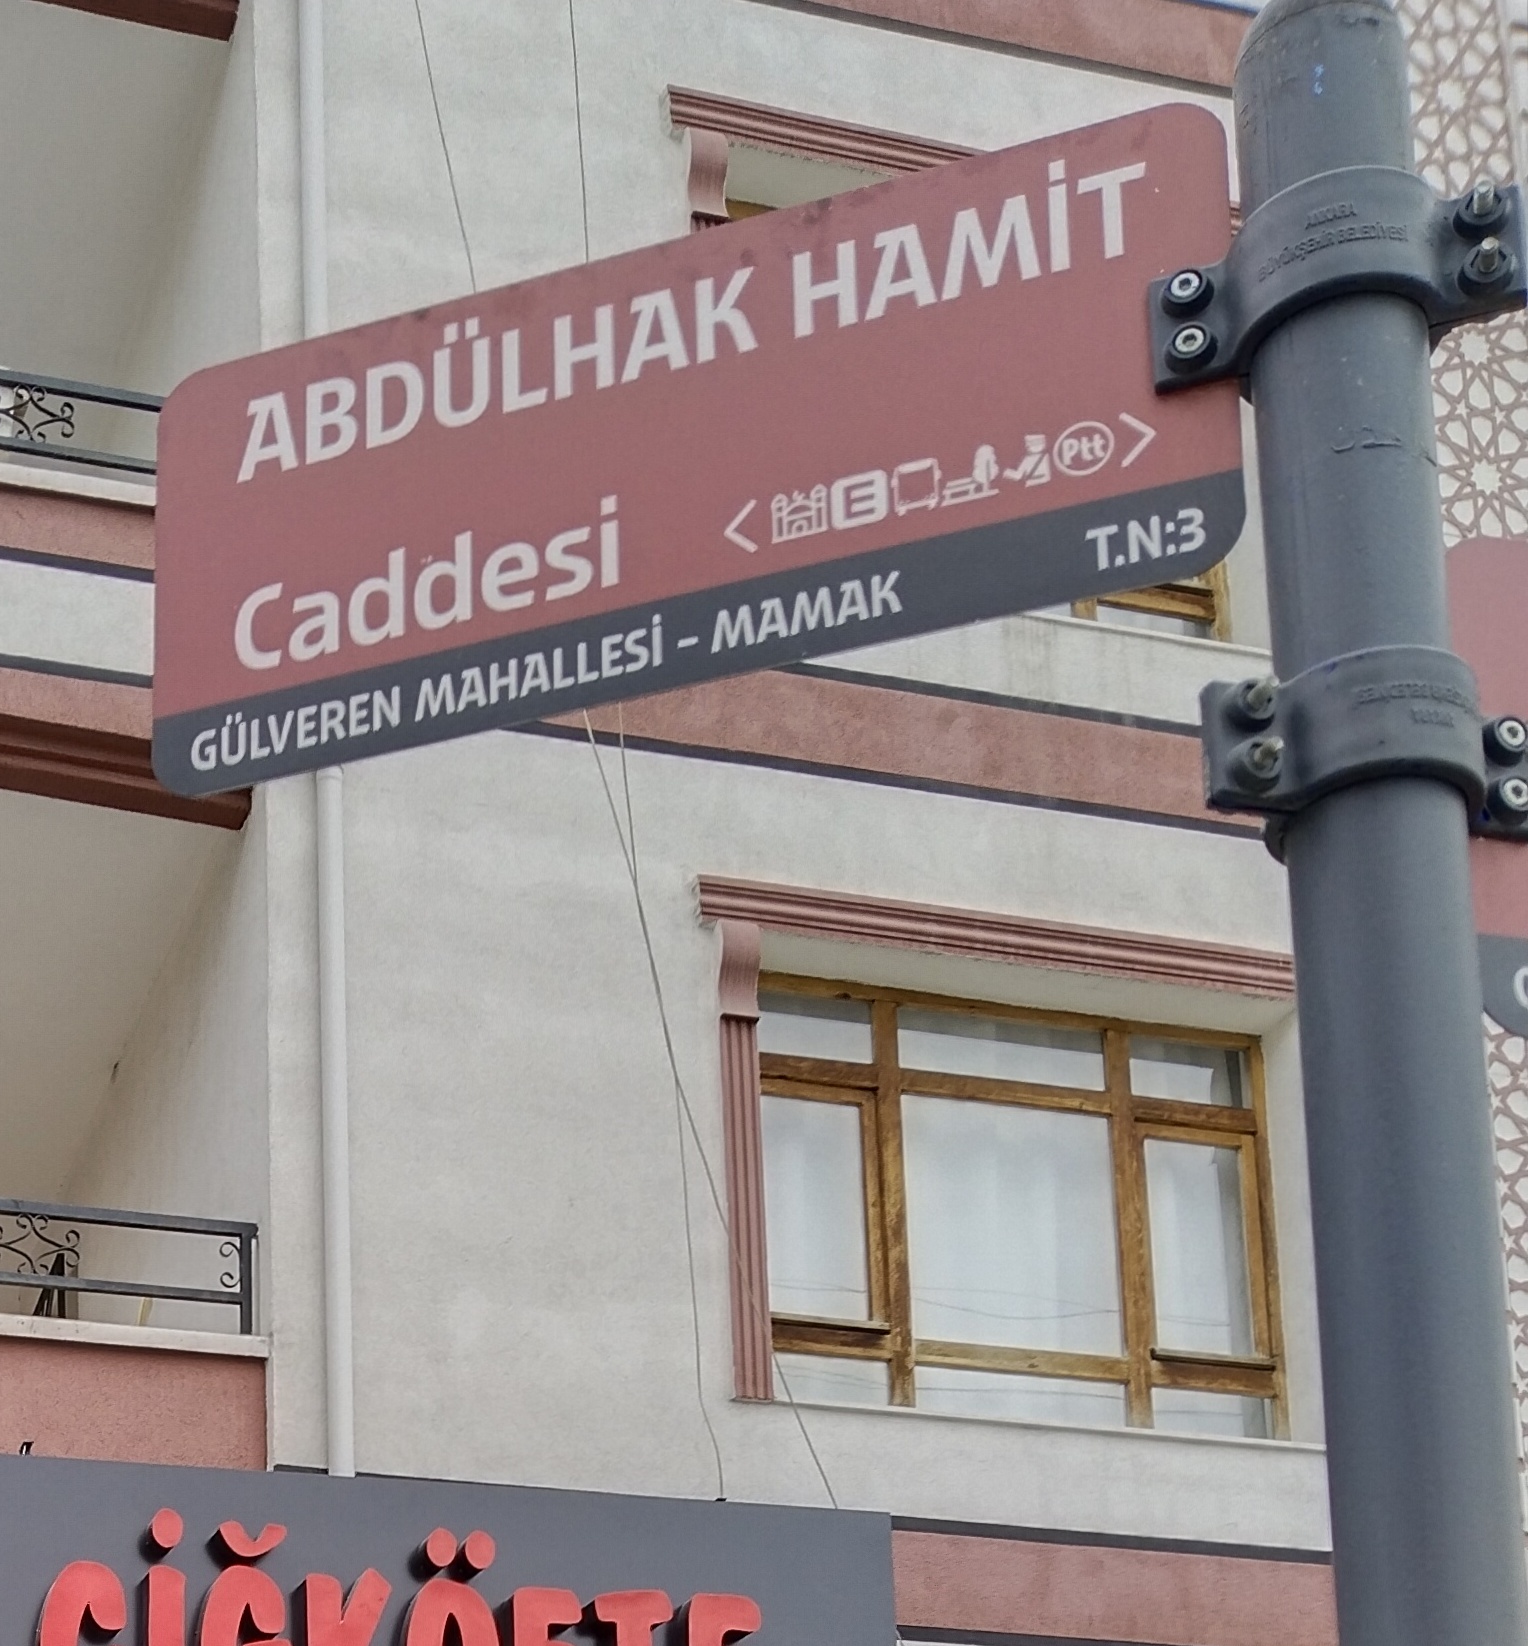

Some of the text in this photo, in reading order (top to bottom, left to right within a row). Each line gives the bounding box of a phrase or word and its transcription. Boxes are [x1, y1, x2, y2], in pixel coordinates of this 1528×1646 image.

[236, 160, 1148, 483] ABDÜLHAK HAMİT
[1060, 432, 1106, 468] Ptt
[234, 494, 622, 671] Caddesi
[1085, 507, 1207, 573] T.N:3
[190, 684, 402, 772] GÜLVEREN
[414, 613, 666, 718] MAHALLESİ
[710, 570, 903, 656] MAMAK
